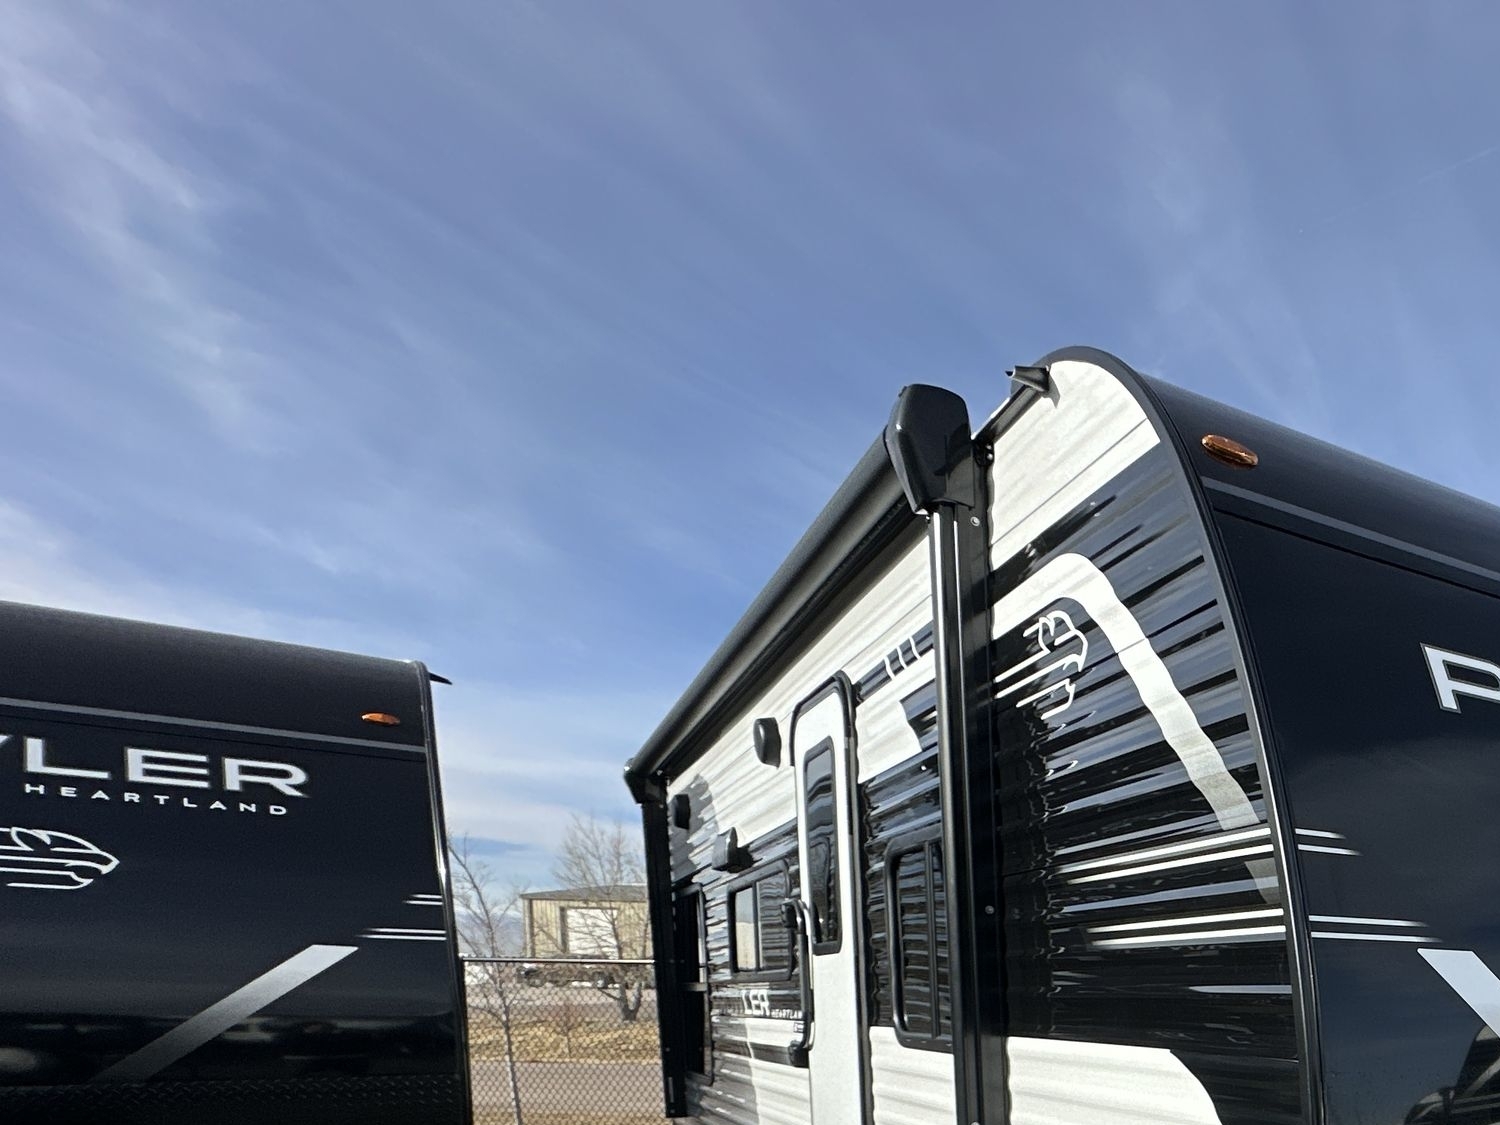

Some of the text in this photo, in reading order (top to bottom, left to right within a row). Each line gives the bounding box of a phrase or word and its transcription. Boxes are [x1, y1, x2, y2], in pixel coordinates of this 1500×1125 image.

[0, 734, 309, 797] LER
[24, 784, 287, 816] HEARTLAND
[771, 1009, 803, 1019] HEARTLAN
